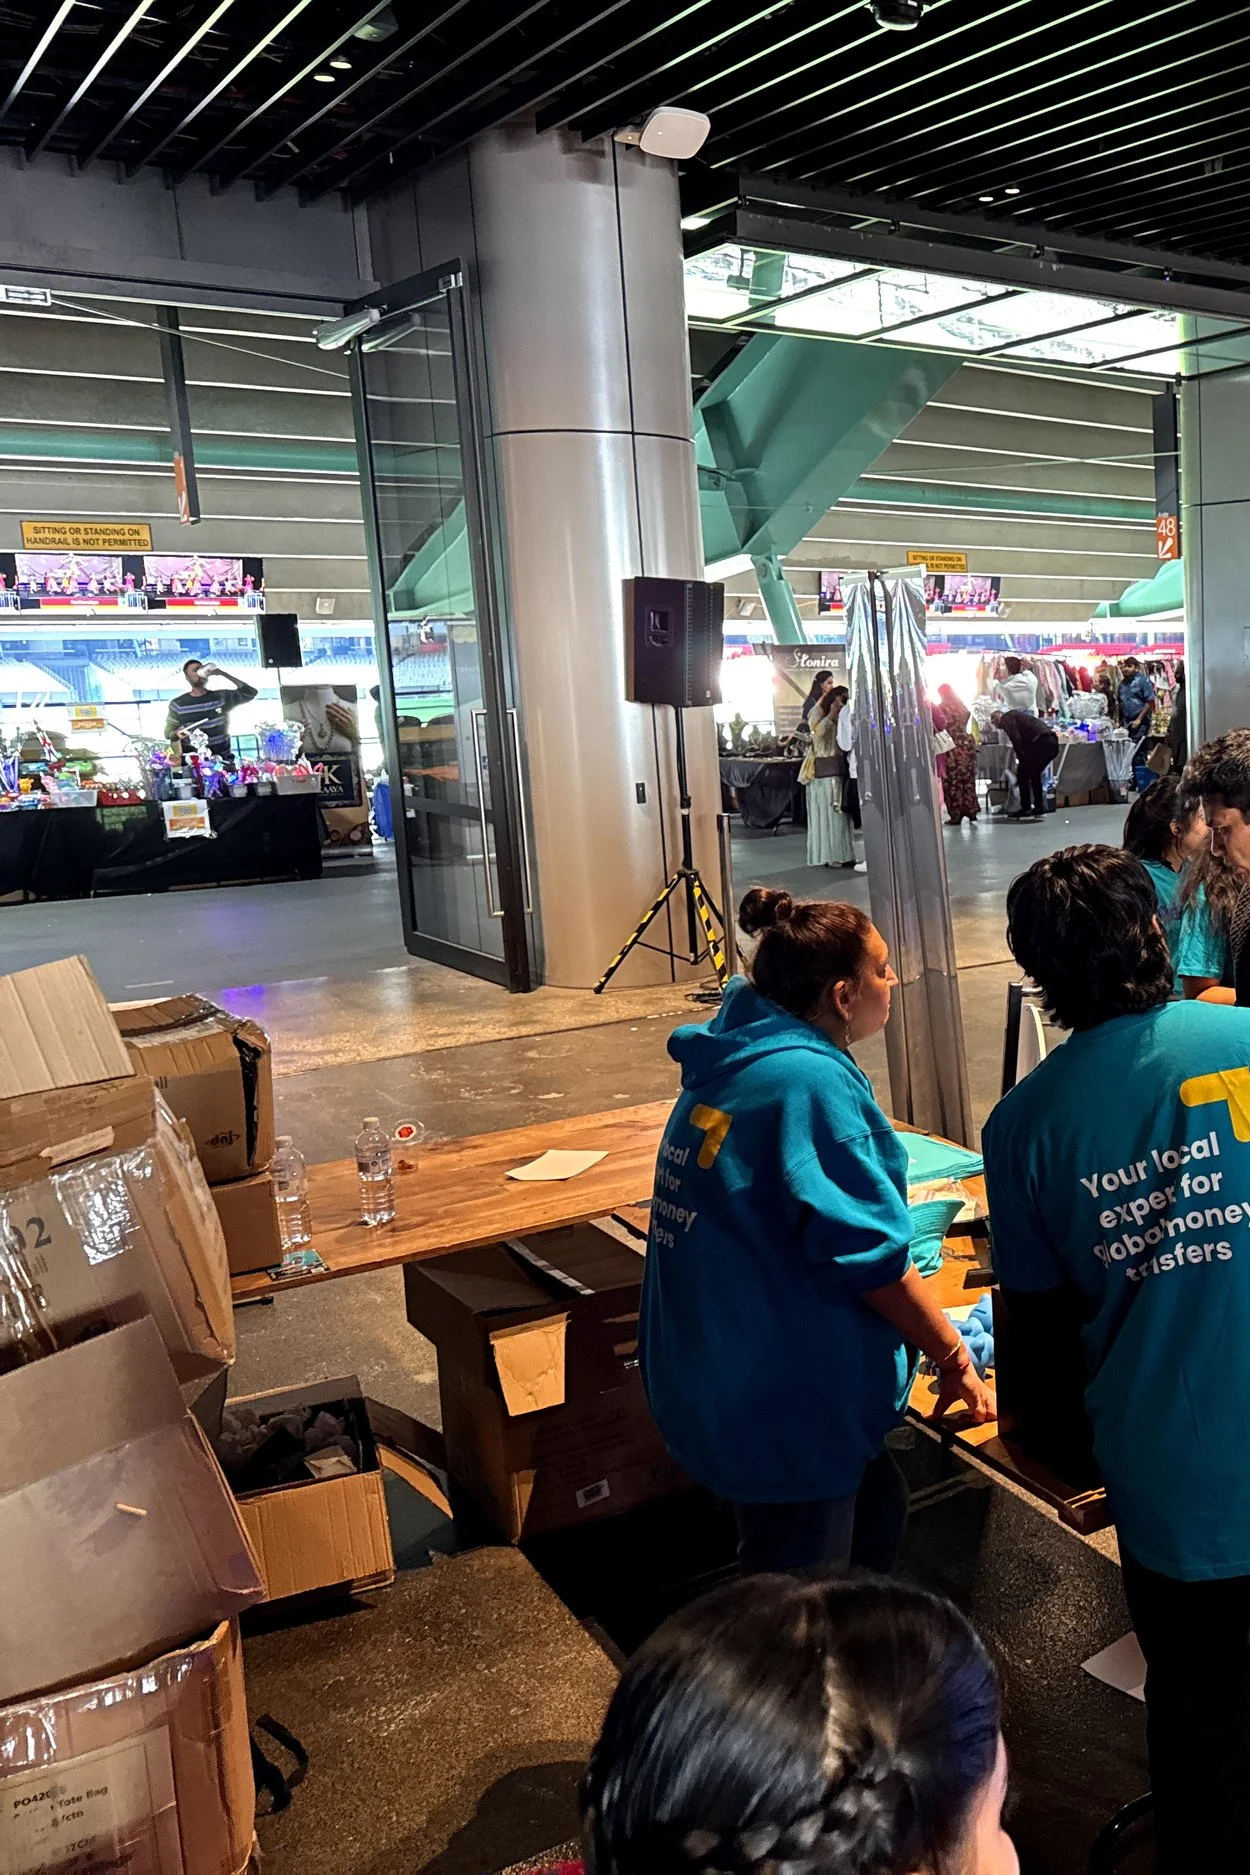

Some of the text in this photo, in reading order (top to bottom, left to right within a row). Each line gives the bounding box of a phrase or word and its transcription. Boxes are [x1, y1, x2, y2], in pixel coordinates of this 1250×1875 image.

[26, 537, 149, 547] HANDRAIL IS NOT PERMITTED
[33, 526, 140, 536] SITTING OR STANDING ON
[1157, 517, 1176, 537] 48
[1080, 1131, 1221, 1198] Your local
[1099, 1171, 1223, 1229] exper for
[1125, 1240, 1233, 1282] trsfers
